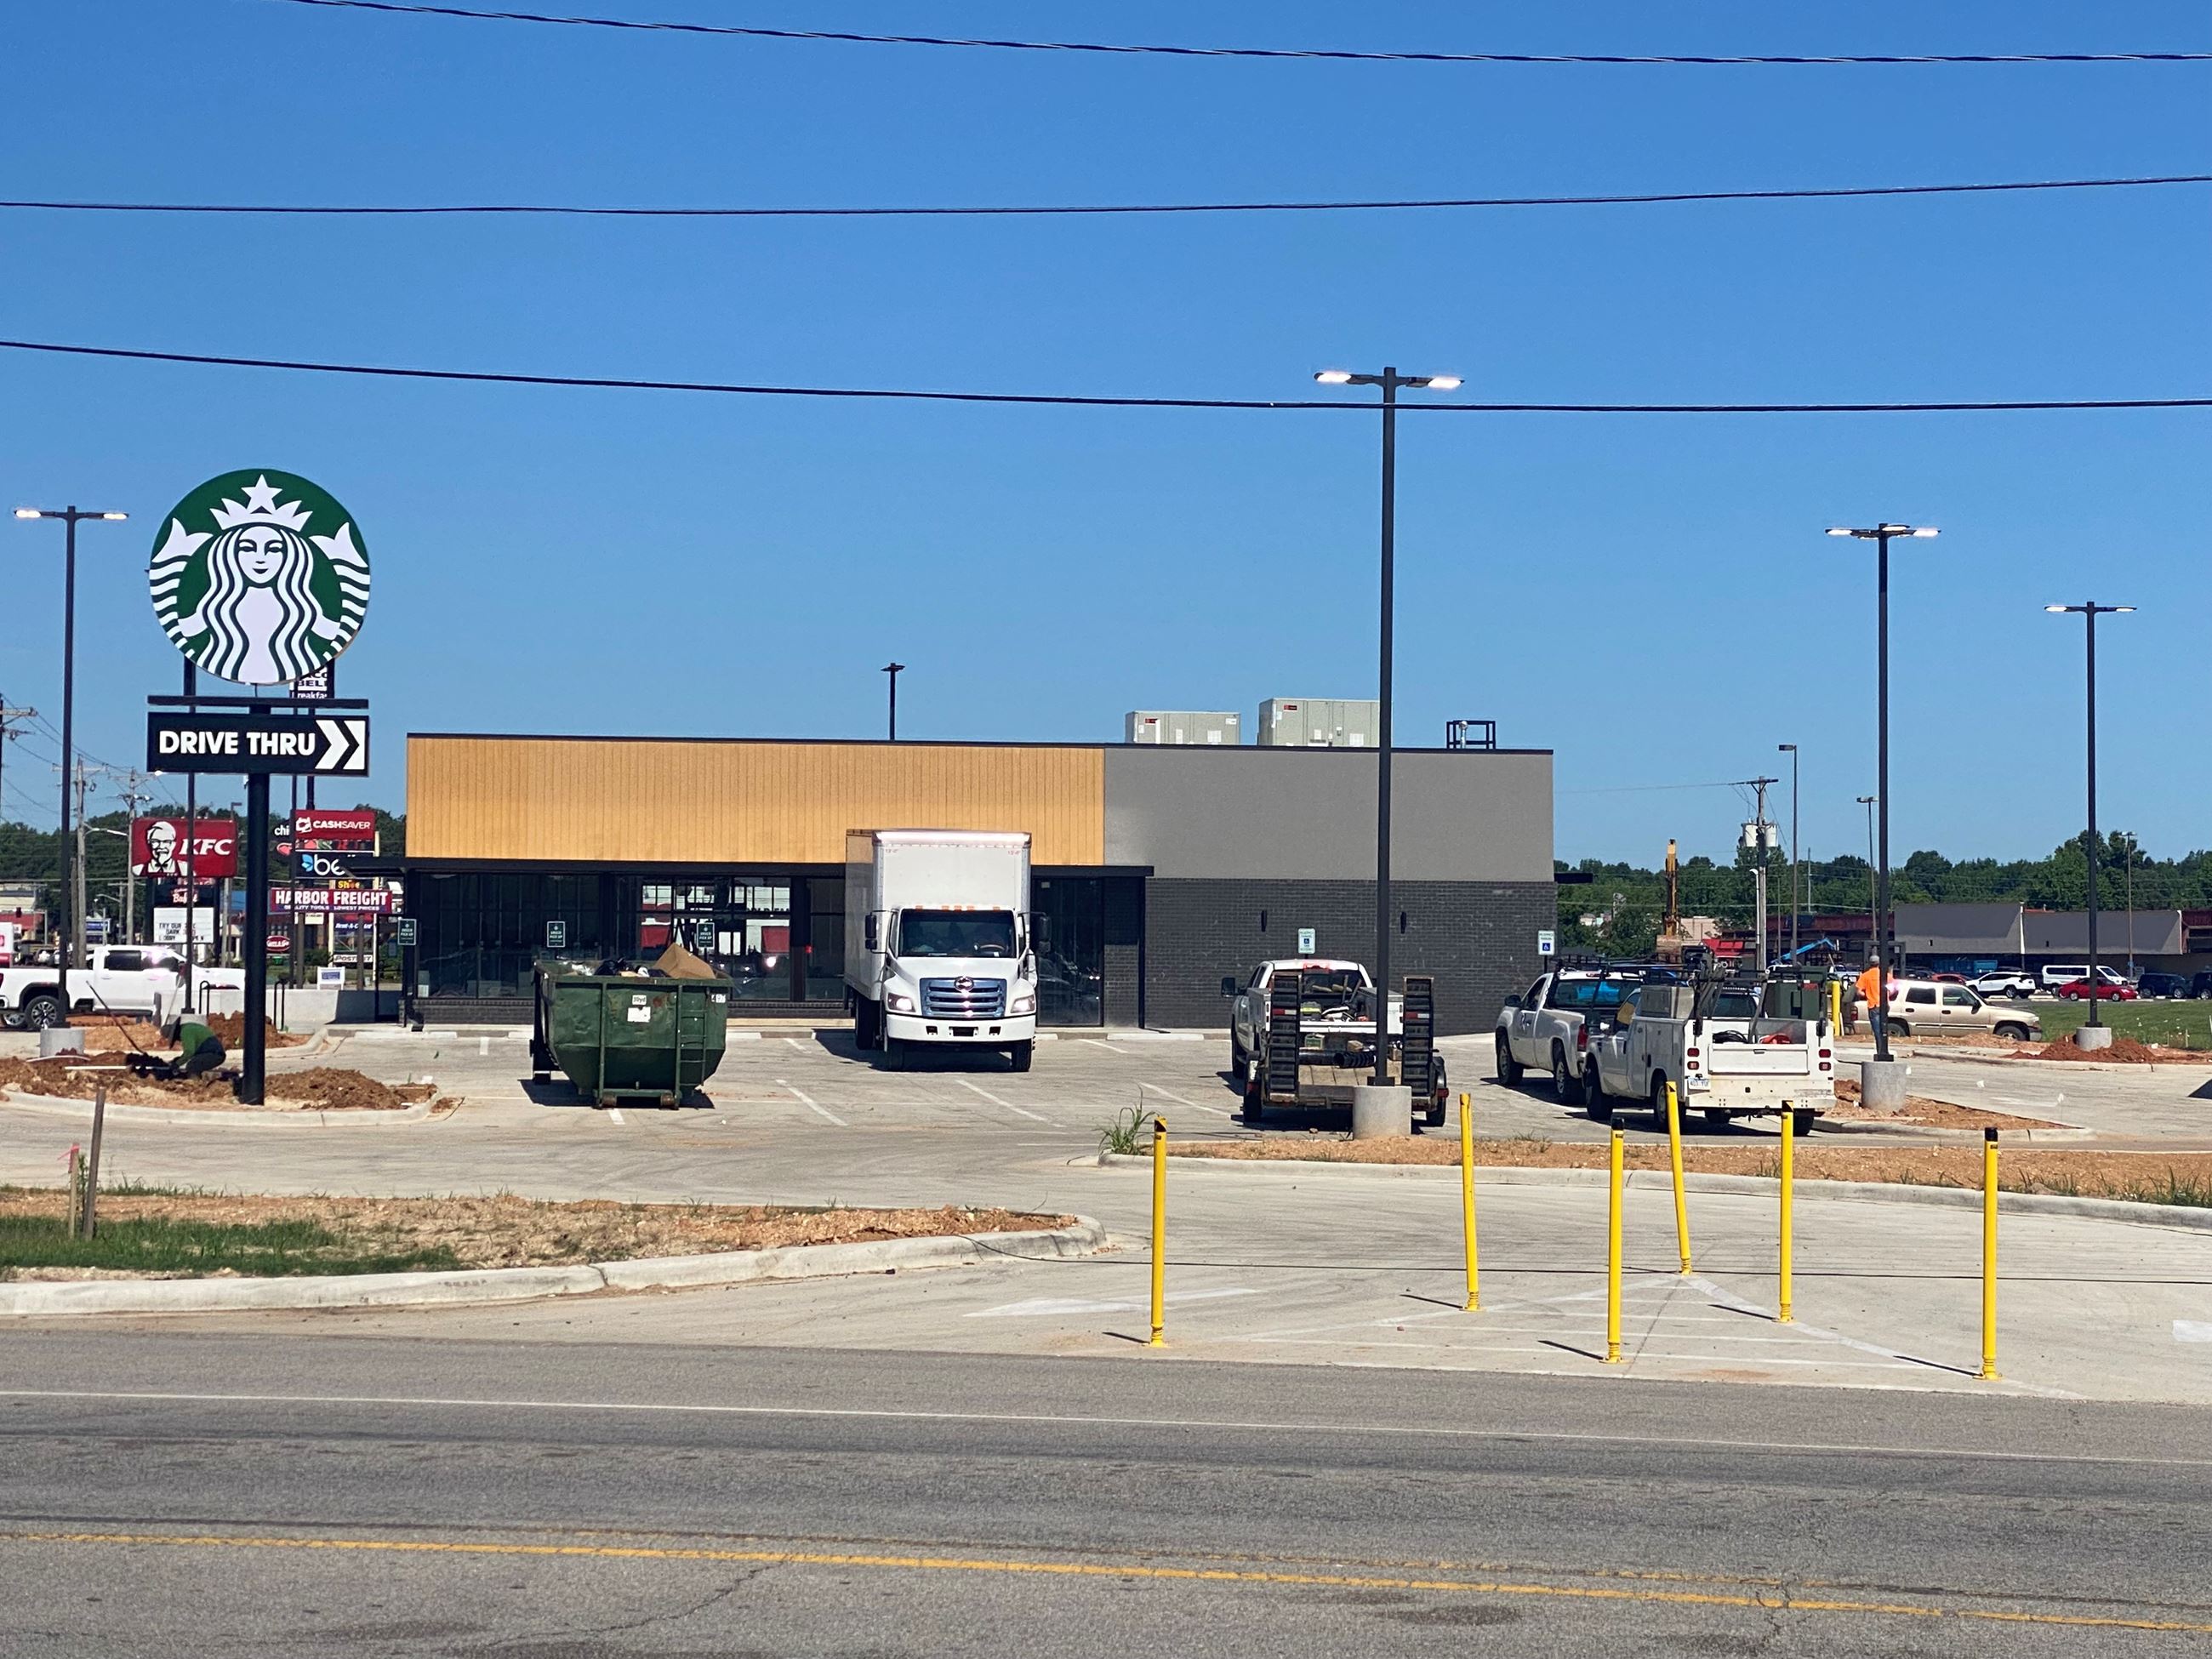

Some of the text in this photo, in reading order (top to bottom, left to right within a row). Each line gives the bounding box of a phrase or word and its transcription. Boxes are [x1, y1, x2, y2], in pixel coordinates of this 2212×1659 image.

[159, 731, 316, 755] DRIVE THRU
[179, 839, 233, 856] KFC
[276, 890, 389, 906] HARBOR FREIGHT
